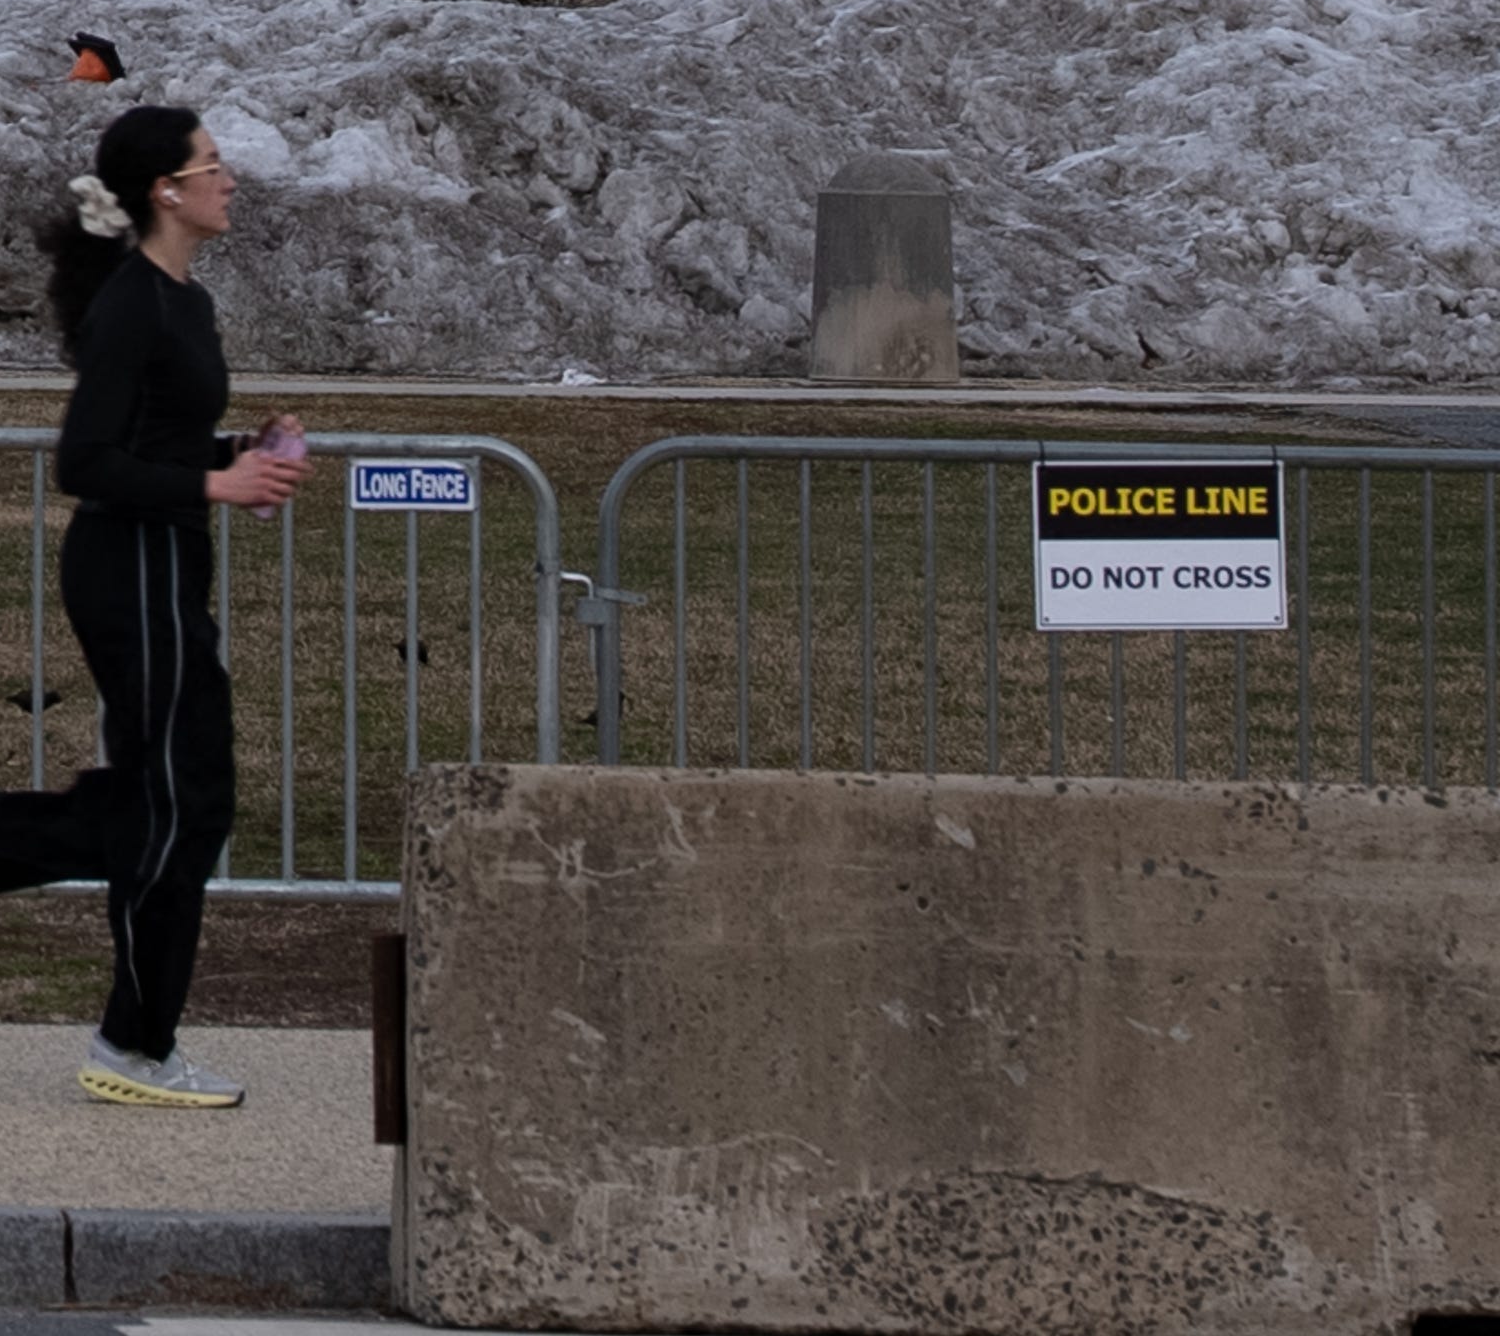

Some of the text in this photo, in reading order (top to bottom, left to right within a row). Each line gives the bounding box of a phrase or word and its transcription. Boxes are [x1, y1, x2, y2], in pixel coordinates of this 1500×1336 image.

[359, 468, 466, 499] LONG FENCE
[1049, 487, 1269, 516] POLICE LINE
[1050, 566, 1272, 589] DO NOT CROSS
